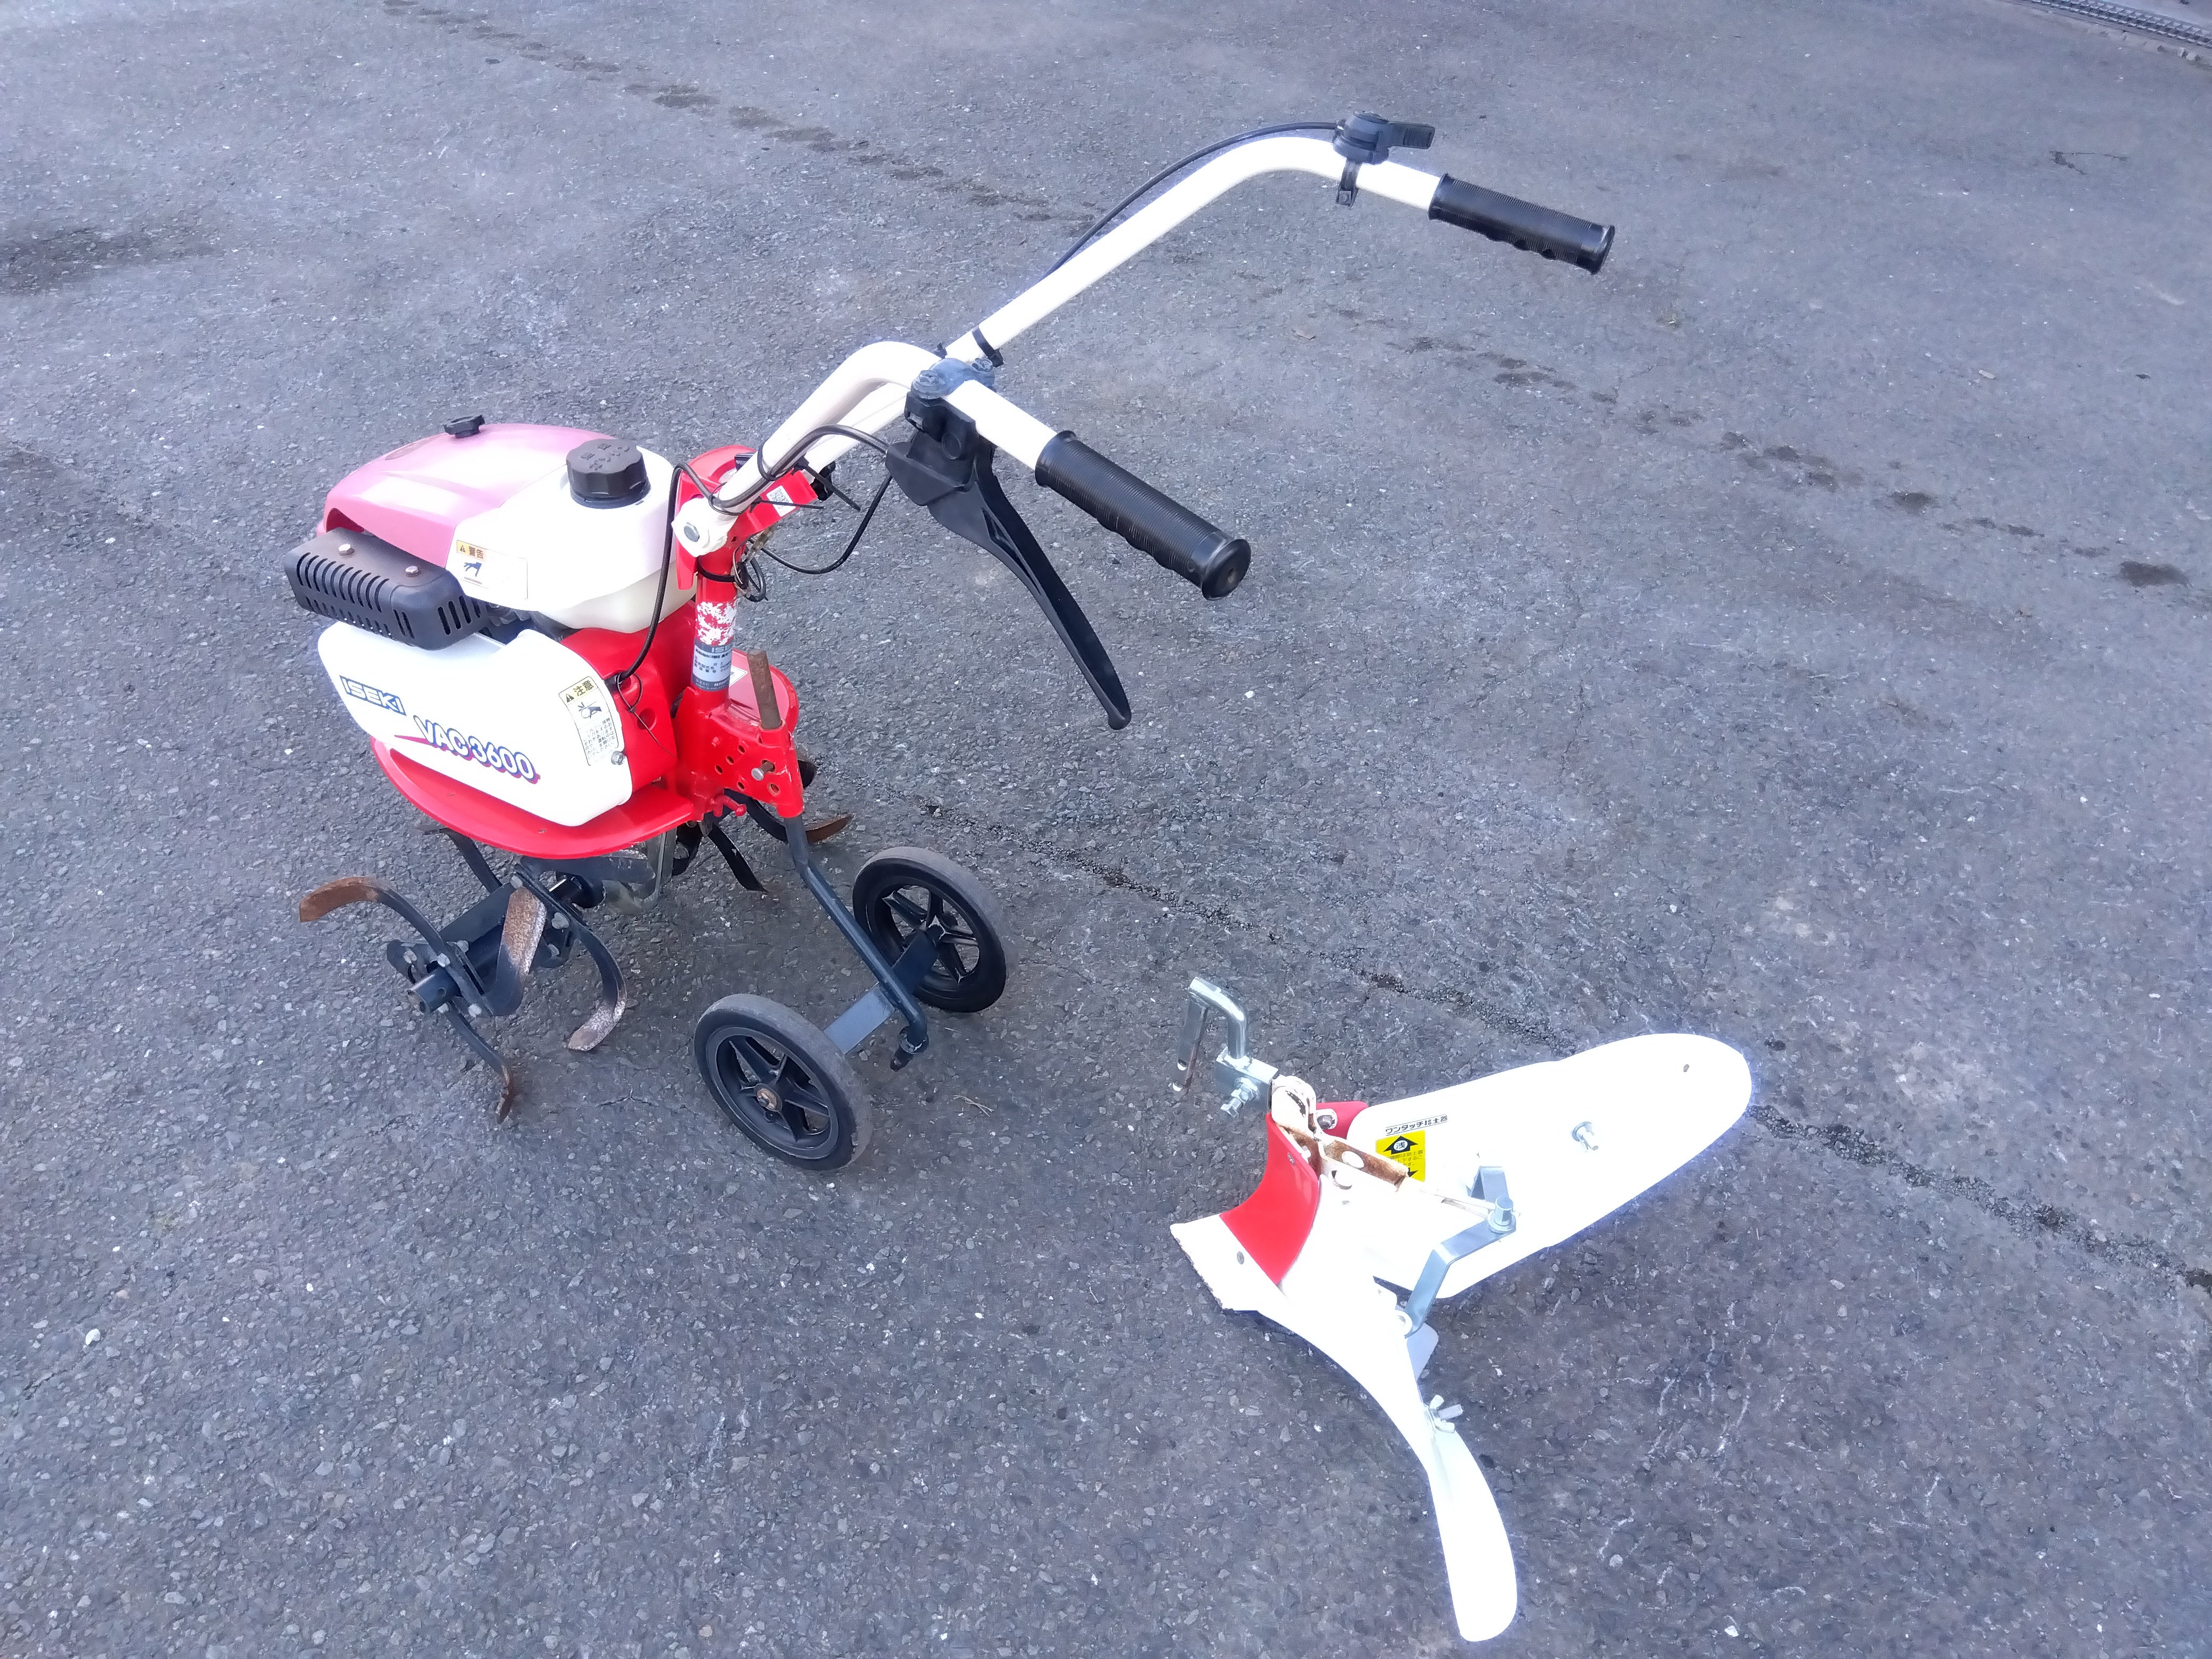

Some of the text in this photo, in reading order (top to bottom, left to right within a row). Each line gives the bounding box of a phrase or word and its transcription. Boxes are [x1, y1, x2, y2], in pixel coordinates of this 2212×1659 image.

[468, 546, 483, 559] 警告
[340, 675, 406, 716] ISEKI
[573, 680, 594, 696] 注意
[413, 715, 539, 783] VAC3600
